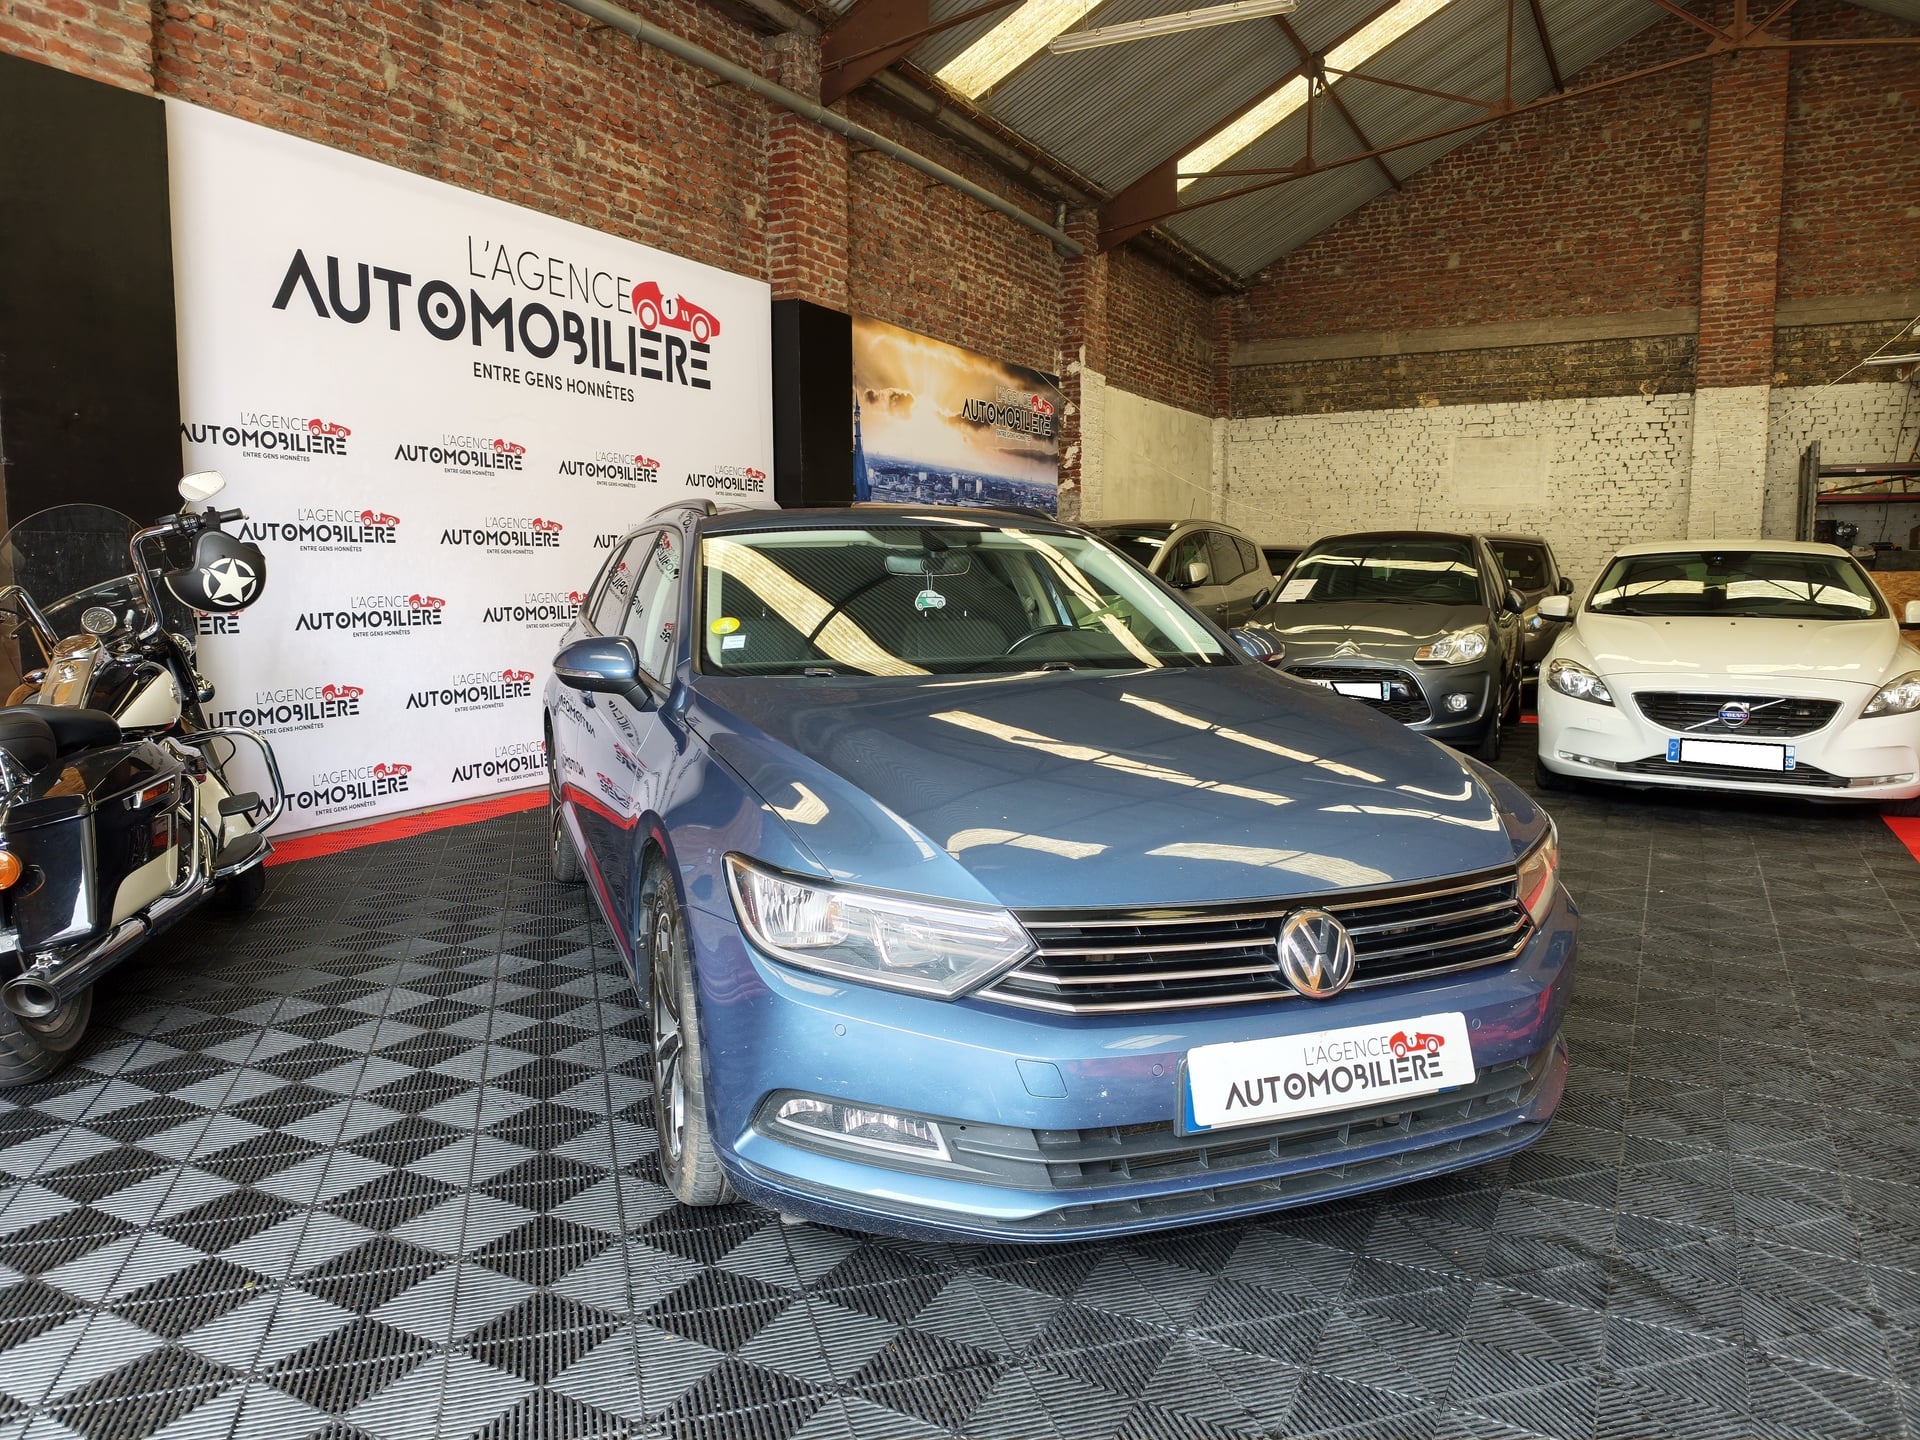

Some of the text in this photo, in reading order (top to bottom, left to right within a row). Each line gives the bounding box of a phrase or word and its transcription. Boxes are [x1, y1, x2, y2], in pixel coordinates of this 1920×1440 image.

[468, 235, 633, 314] L'AGENCE
[271, 248, 711, 390] AUTOMOBILIERE
[473, 362, 635, 403] ENTRE GENS HONNÊTES
[241, 411, 309, 432] L'AGENCE
[961, 398, 1051, 436] AUTOMOBILIERE
[443, 434, 494, 450] L'AGENCE
[394, 444, 522, 471] AUTOMOBILIERE
[596, 451, 635, 465] L'AGENCE
[559, 460, 657, 483] AUTOMOBILIERE
[686, 474, 764, 492] AUTOMOBILIERE
[298, 508, 360, 523] L'AGENCE
[486, 516, 533, 529] L'AGENCE
[238, 522, 396, 544] AUTOMOBILIERE
[440, 529, 560, 547] AUTOMOBILIERE
[594, 535, 623, 548] AUT
[351, 595, 409, 609] L'AGENCE
[525, 592, 570, 604] L'AGENCE
[295, 609, 442, 631] AUTOMOBILIERE
[483, 605, 579, 622] AUTOMOBILIE
[453, 671, 502, 686] L'AGENCE
[256, 686, 322, 705] L'AGENCE
[406, 682, 531, 709] AUTOMOBILIERE
[209, 698, 360, 728] UTOMOBILIERE
[495, 741, 541, 757] L'AGENCE
[313, 766, 374, 787] L'AGENCE
[1304, 1036, 1390, 1066] L'AGENCE
[1410, 1037, 1414, 1046] 1
[1225, 1052, 1443, 1110] AUTOMOBILIERE
